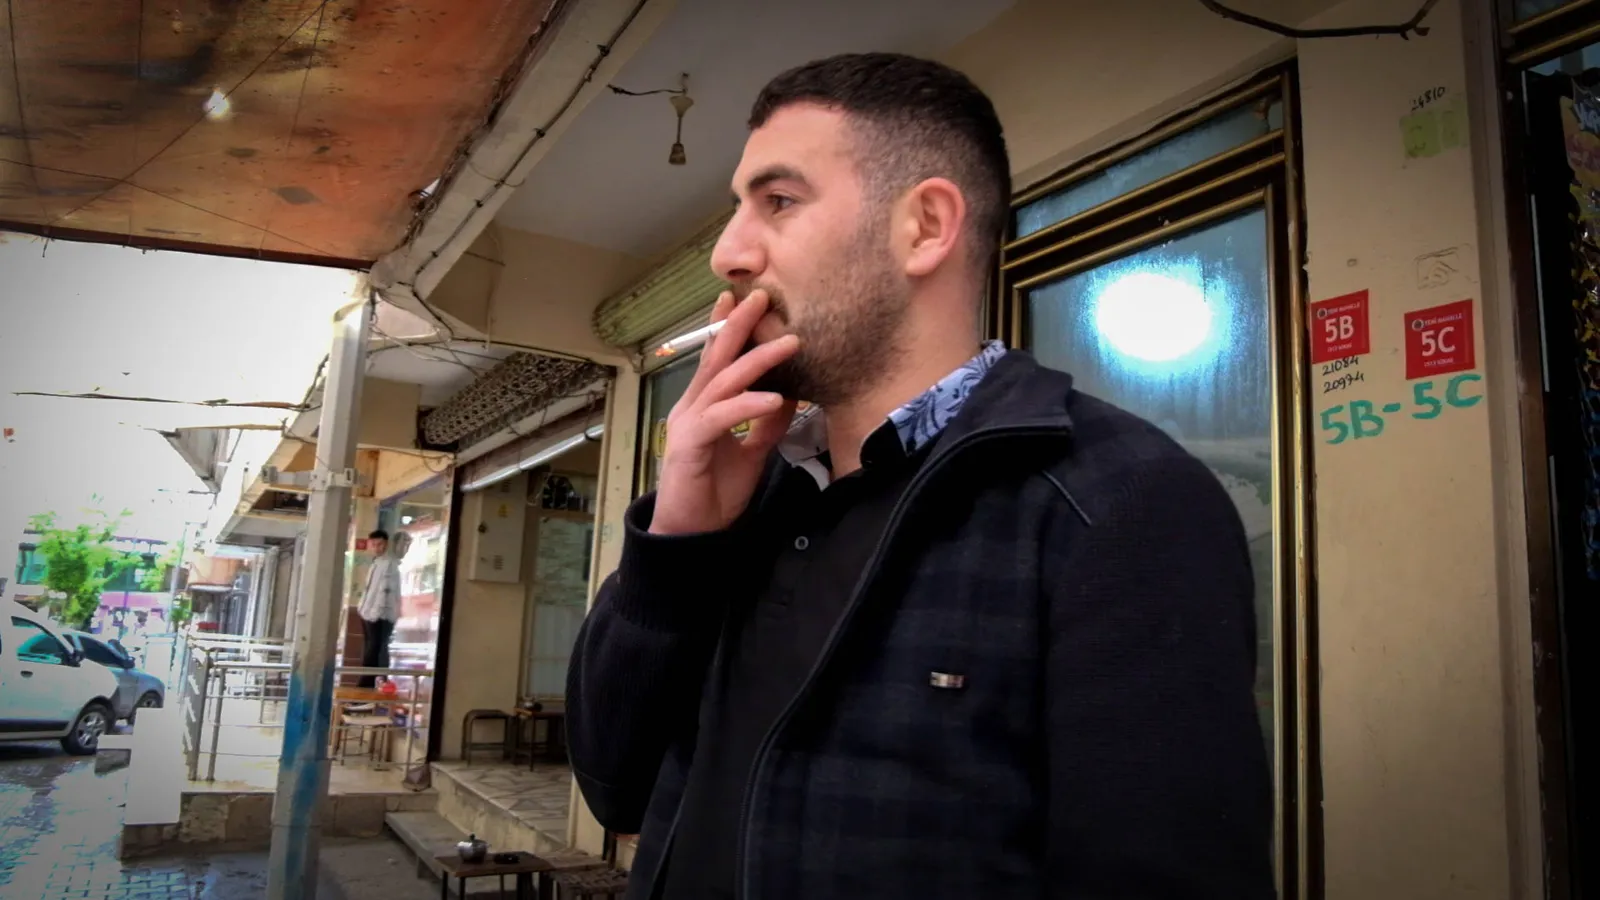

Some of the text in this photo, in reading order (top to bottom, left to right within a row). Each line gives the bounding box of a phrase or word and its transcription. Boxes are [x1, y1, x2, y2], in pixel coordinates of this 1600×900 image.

[1325, 315, 1354, 343] 5B
[1421, 326, 1456, 357] 5C
[1322, 355, 1359, 376] 21084
